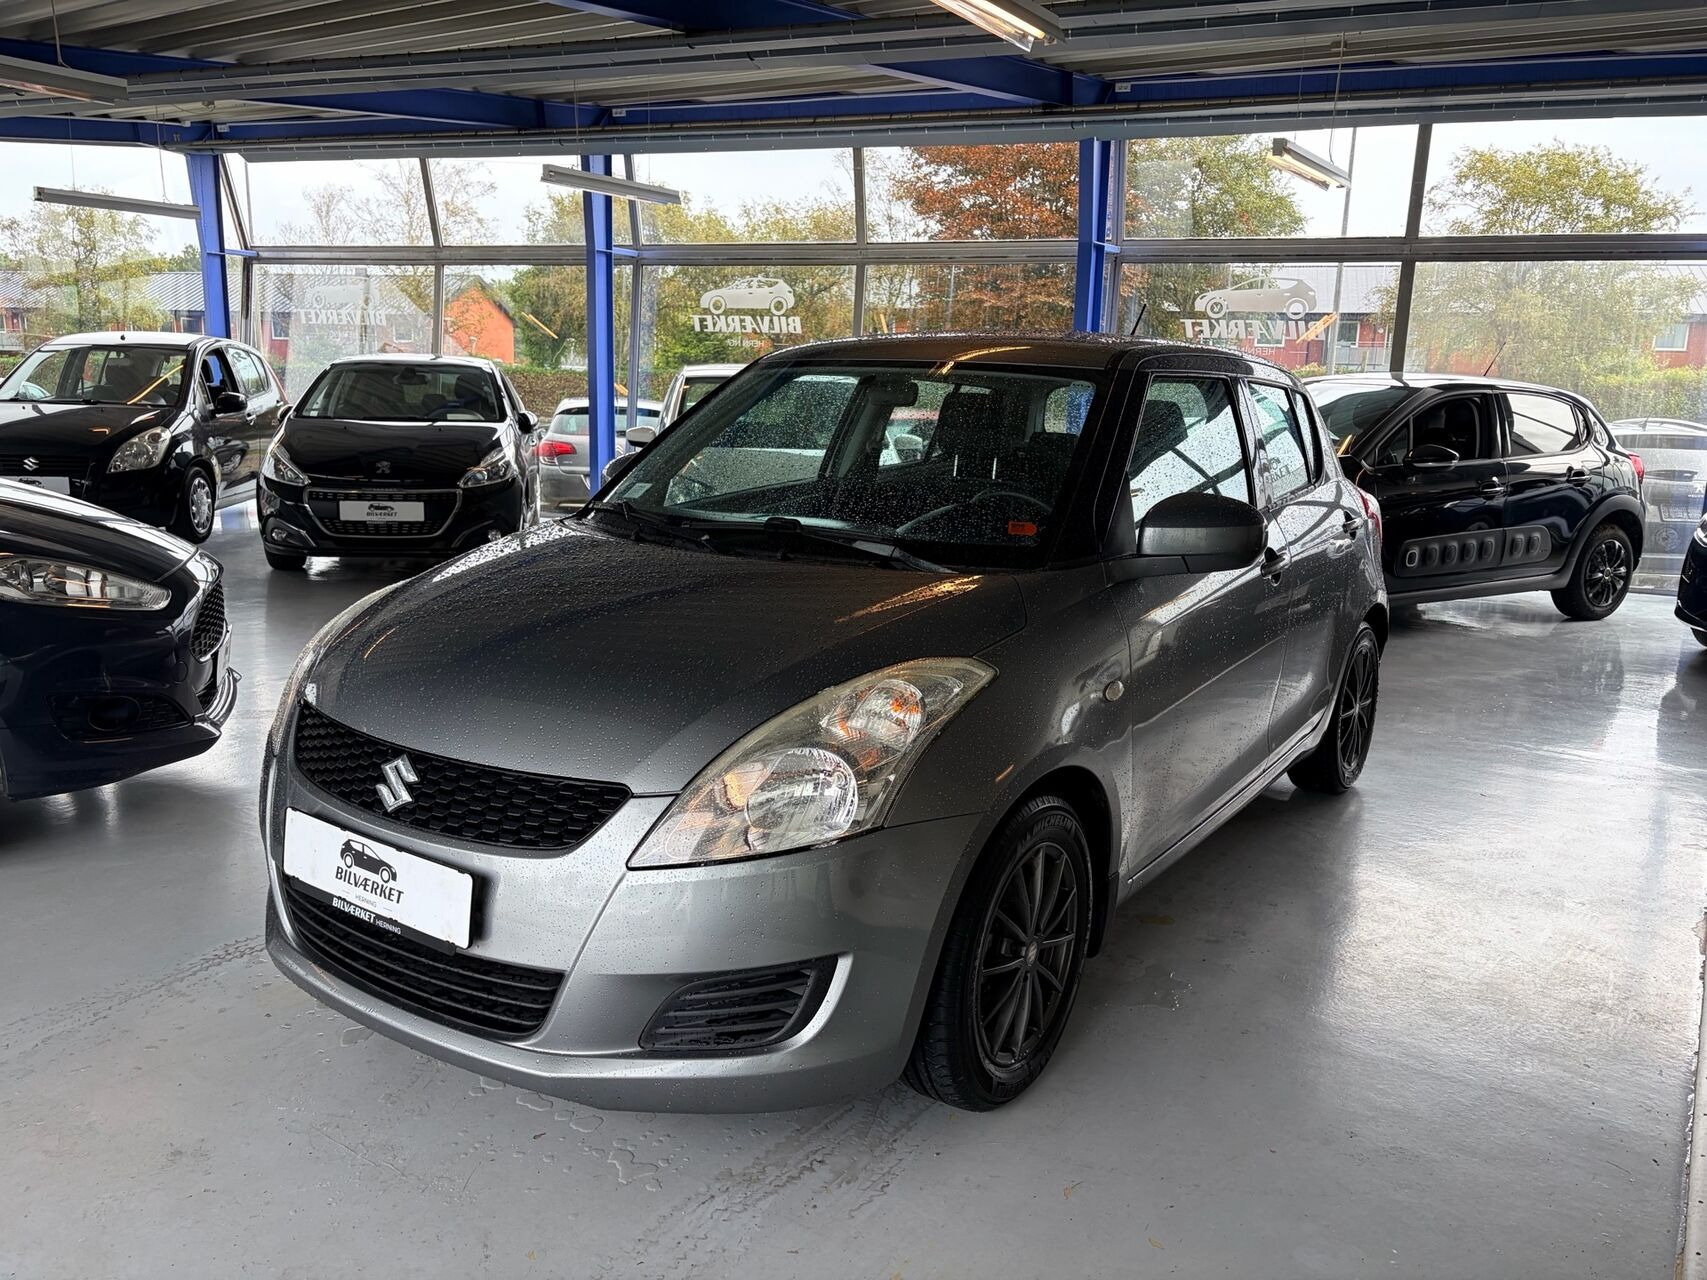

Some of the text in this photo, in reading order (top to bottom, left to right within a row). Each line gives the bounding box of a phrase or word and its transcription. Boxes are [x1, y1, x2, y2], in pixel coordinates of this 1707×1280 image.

[335, 865, 404, 904] BILVÆRKET
[332, 897, 401, 935] BILVÆRKET HERNING
